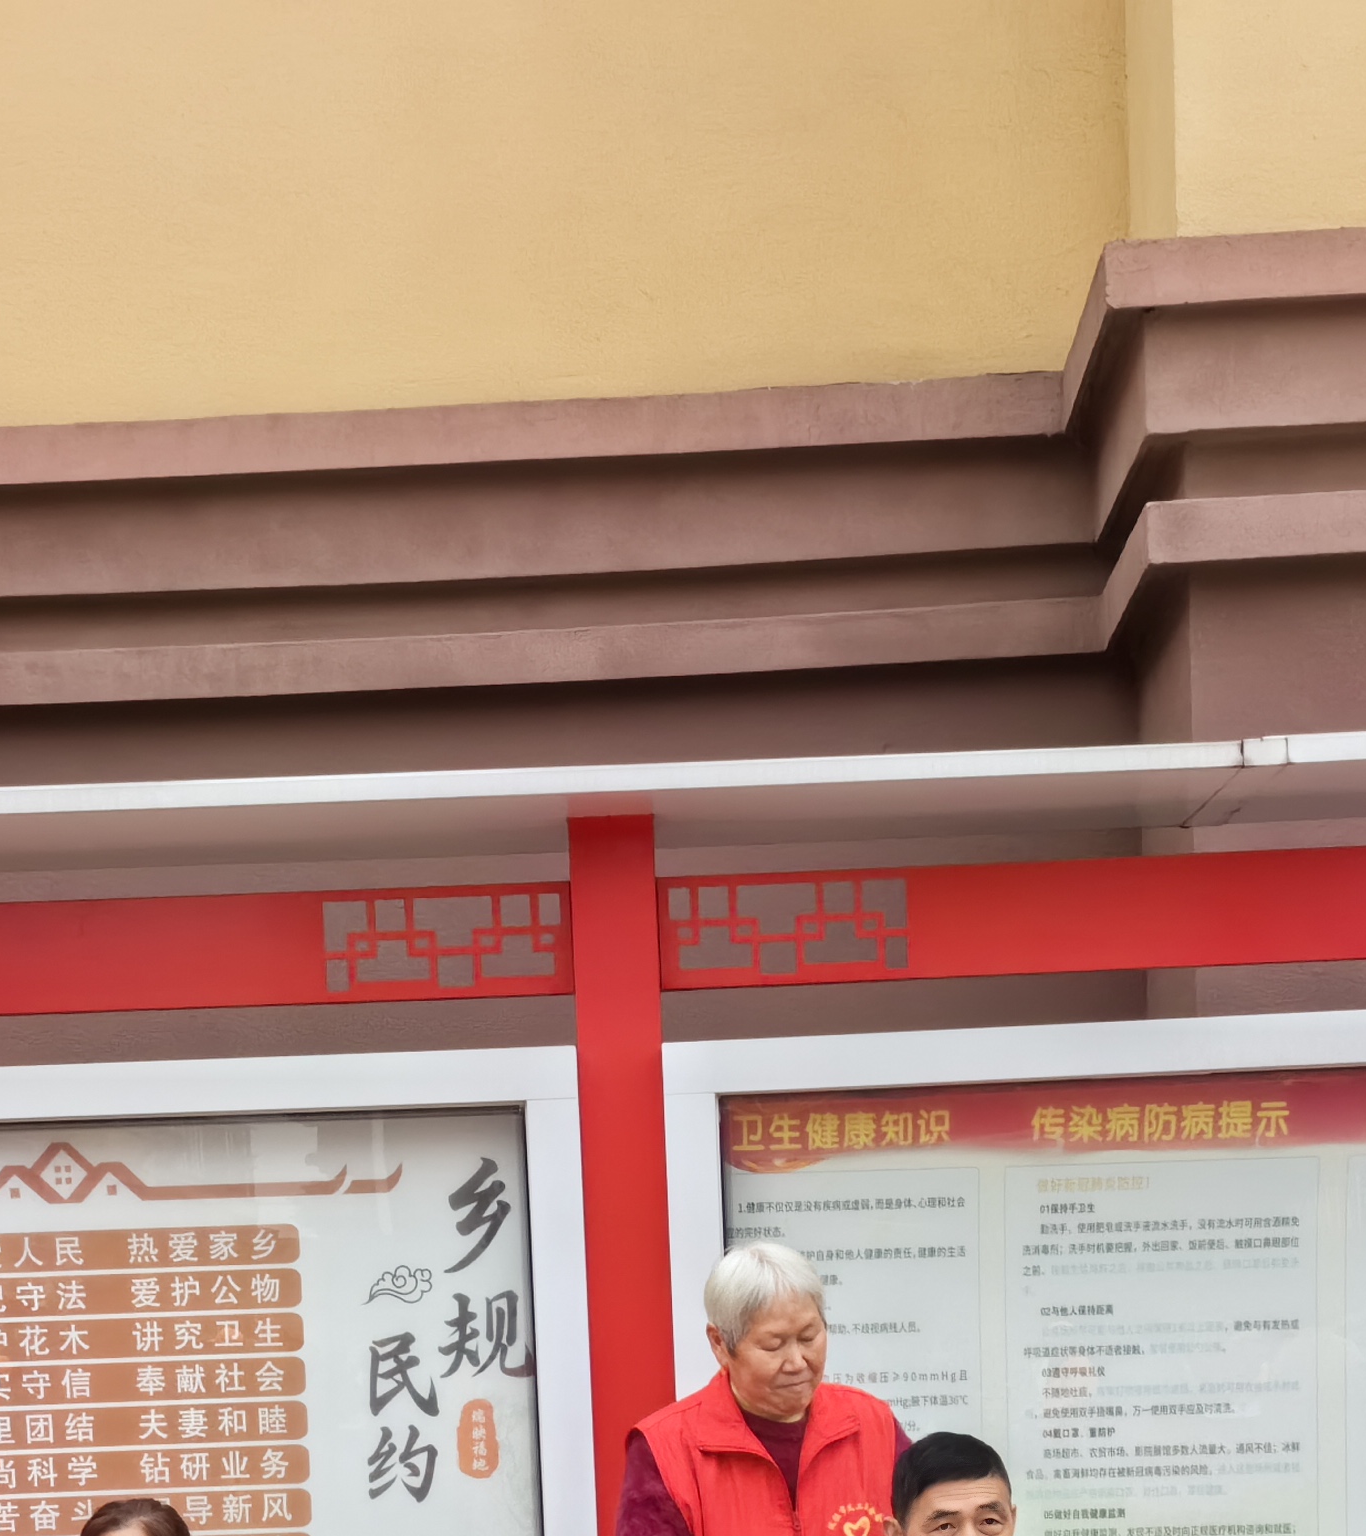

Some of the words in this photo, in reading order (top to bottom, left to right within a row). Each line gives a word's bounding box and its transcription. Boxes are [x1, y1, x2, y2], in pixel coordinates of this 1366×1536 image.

[732, 1109, 951, 1151] 卫生健康知识
[1031, 1099, 1290, 1143] 传染病防病提示
[127, 1230, 277, 1264] 热爱家乡
[438, 1157, 533, 1379] 乡规
[130, 1273, 281, 1309] 爱护公物
[132, 1317, 284, 1353] 讲究卫生
[135, 1361, 286, 1397] 奉献社会
[138, 1405, 288, 1440] 夫妻和睦
[367, 1332, 439, 1504] 民约
[140, 1449, 290, 1484] 钻研业务
[160, 1492, 293, 1526] 导新风
